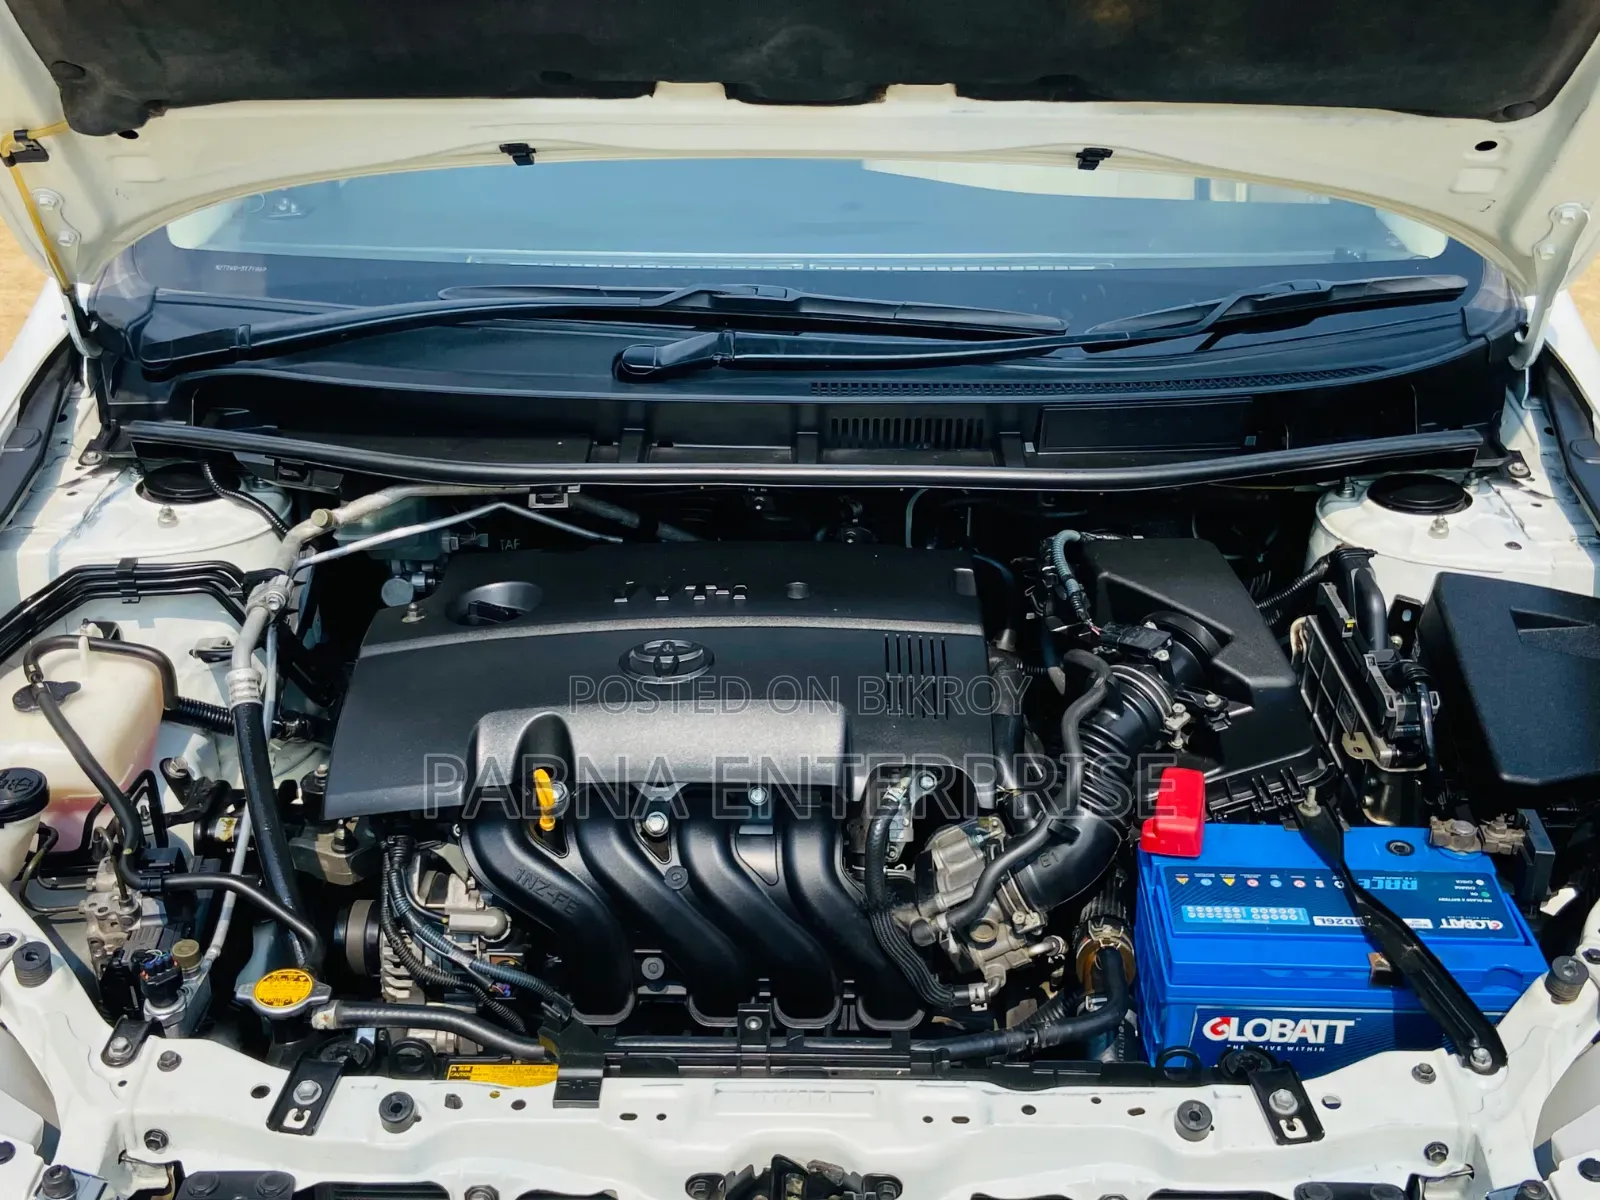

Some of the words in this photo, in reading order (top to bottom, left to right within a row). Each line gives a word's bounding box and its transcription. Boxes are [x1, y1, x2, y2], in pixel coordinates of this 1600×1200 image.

[516, 868, 580, 915] 1NZ-FE
[1357, 879, 1418, 891] RACE
[1439, 918, 1503, 929] GLOBATT
[1202, 1016, 1355, 1045] GLOBATT
